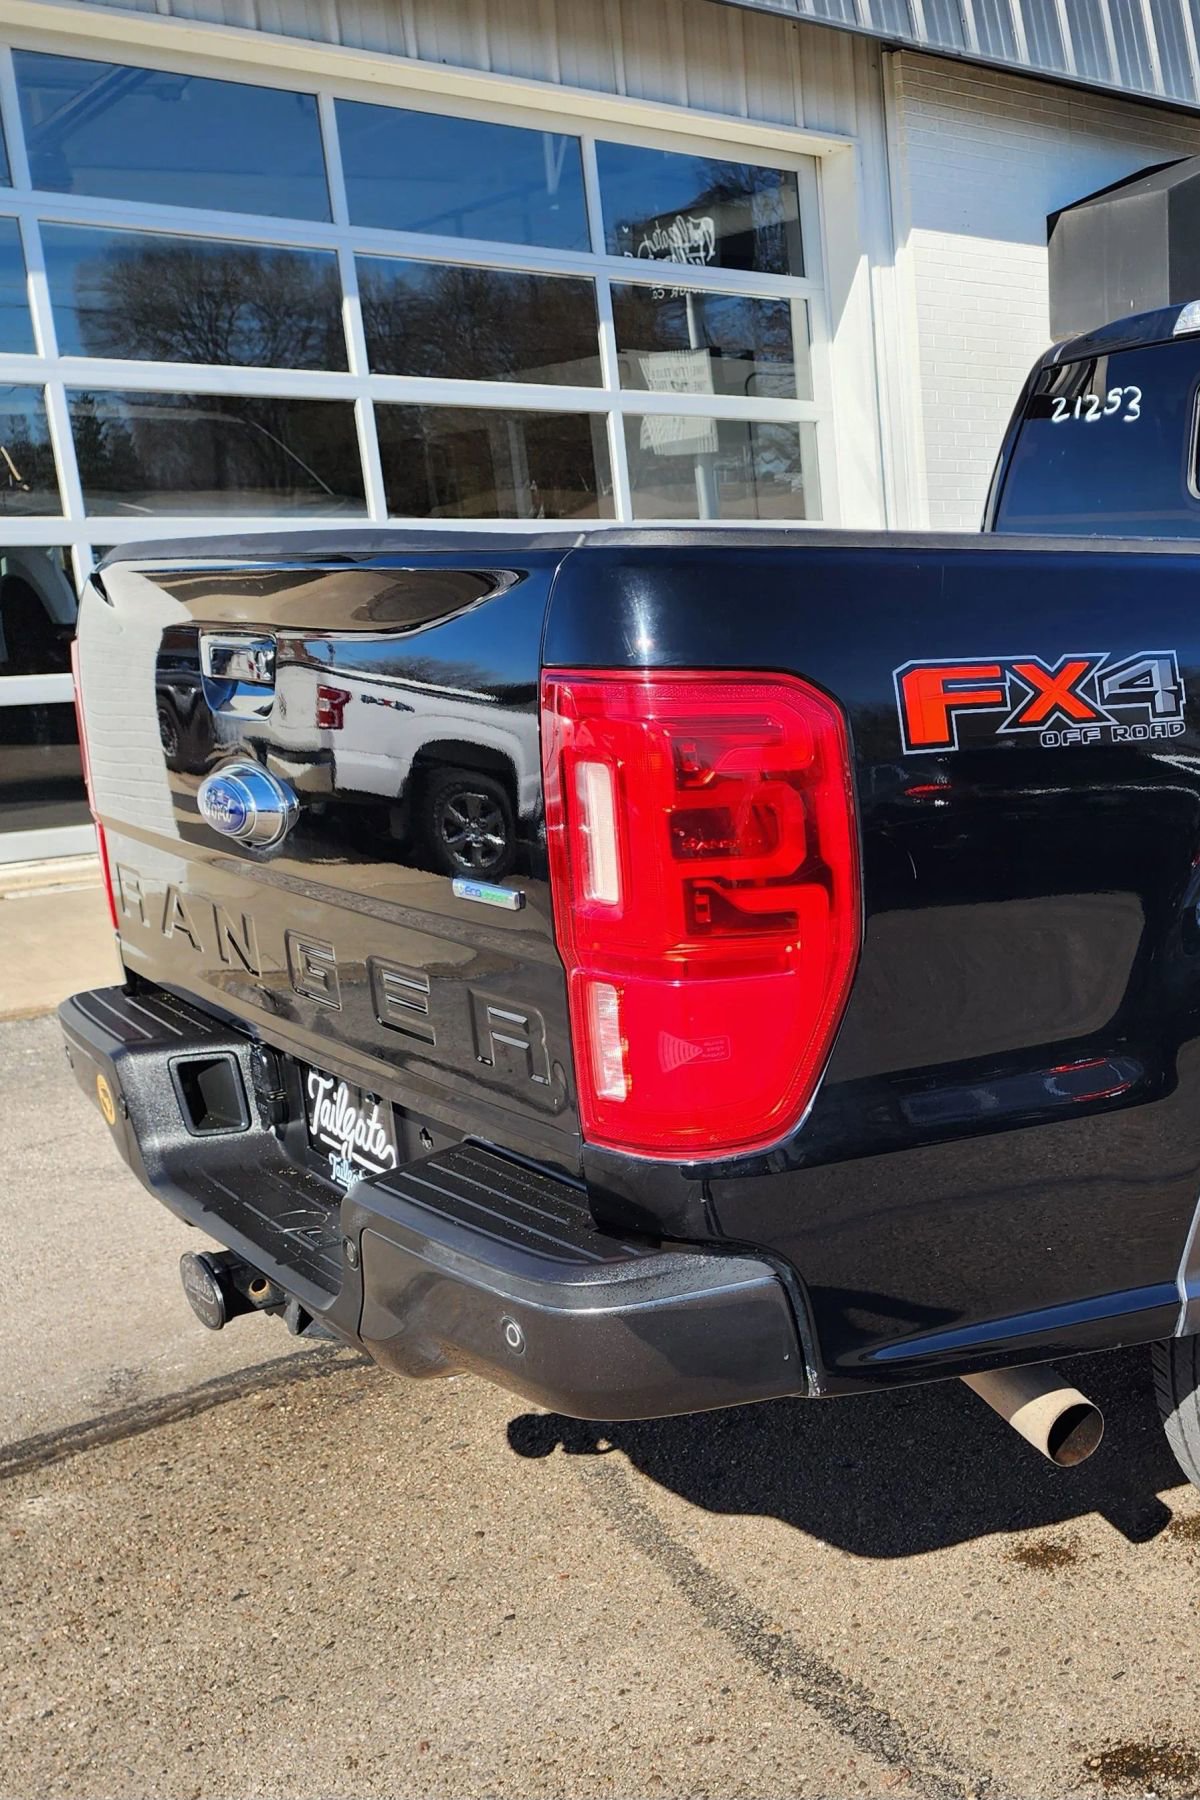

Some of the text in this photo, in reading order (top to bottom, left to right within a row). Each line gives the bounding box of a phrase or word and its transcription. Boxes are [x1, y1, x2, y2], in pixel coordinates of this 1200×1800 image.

[1051, 386, 1142, 423] 21253
[895, 652, 1186, 752] FX4
[1040, 721, 1186, 748] OFF ROAD
[115, 861, 552, 1086] RANGER
[308, 1069, 397, 1168] Tailgate
[328, 1152, 367, 1190] Tailgat
